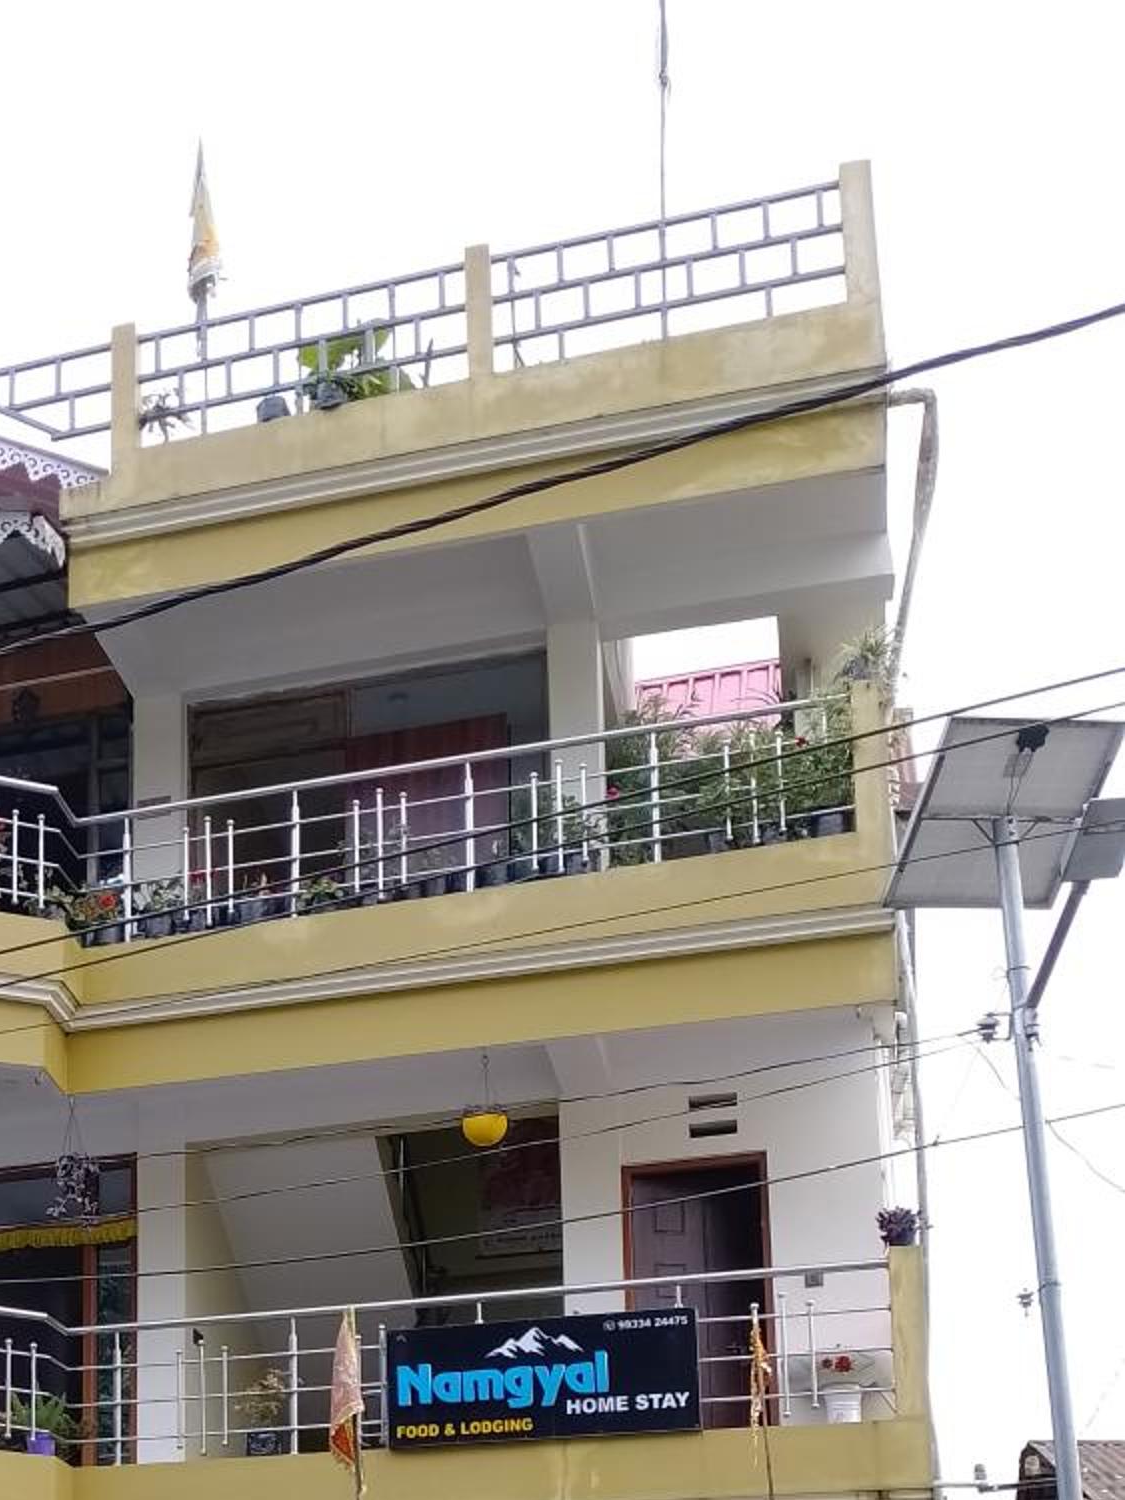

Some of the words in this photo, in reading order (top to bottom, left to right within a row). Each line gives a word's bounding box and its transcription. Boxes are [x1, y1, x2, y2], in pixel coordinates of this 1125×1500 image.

[396, 1350, 609, 1408] Namgyal
[566, 1396, 630, 1415] HOME
[635, 1391, 690, 1411] STAY
[396, 1423, 440, 1439] FOOD
[444, 1423, 455, 1436] &
[460, 1418, 534, 1435] LODGING
